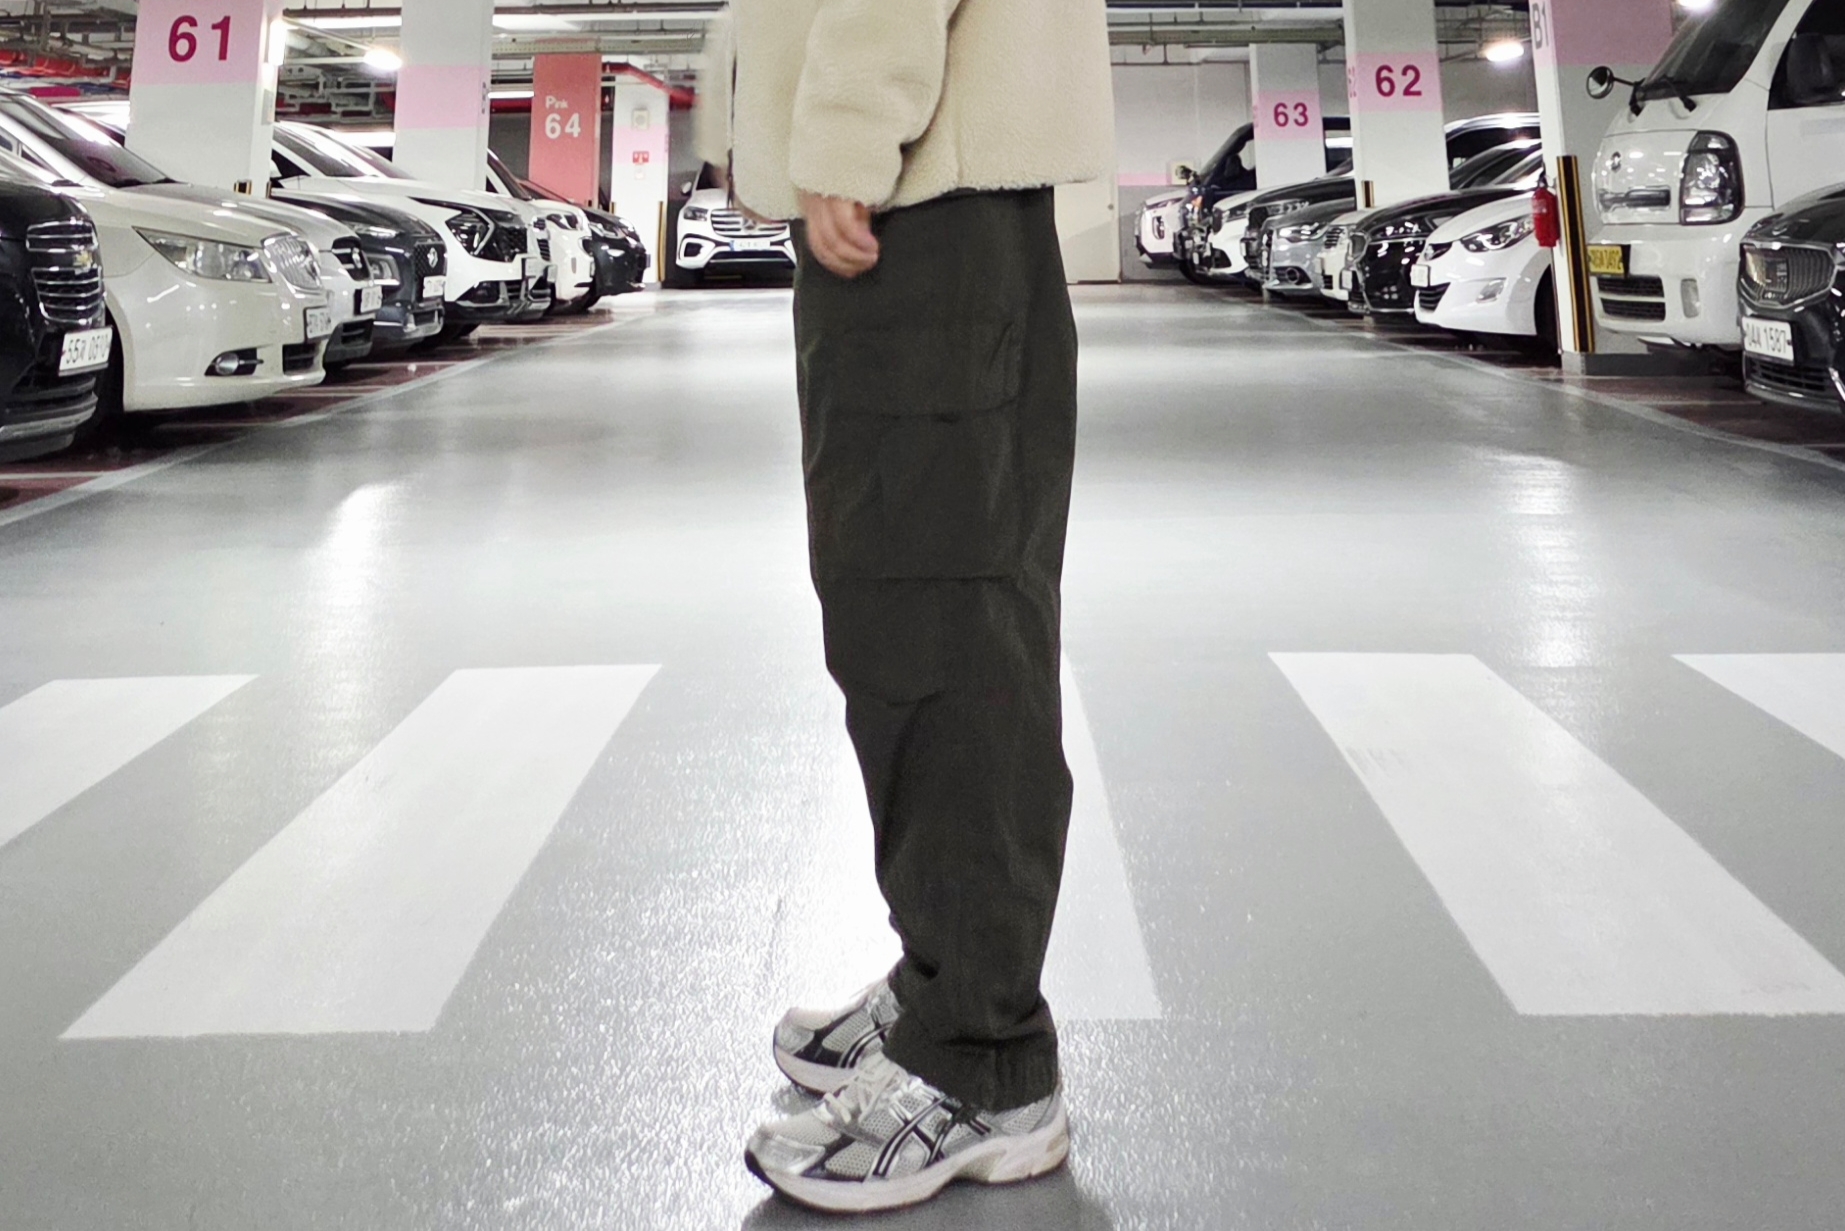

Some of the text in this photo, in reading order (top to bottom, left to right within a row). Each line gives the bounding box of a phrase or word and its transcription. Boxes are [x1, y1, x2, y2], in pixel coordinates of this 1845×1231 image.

[168, 15, 231, 63] 61
[1532, 0, 1549, 49] B1
[1375, 64, 1422, 97] 62
[545, 95, 568, 109] Pink
[1273, 102, 1309, 127] 63
[545, 113, 581, 139] 64
